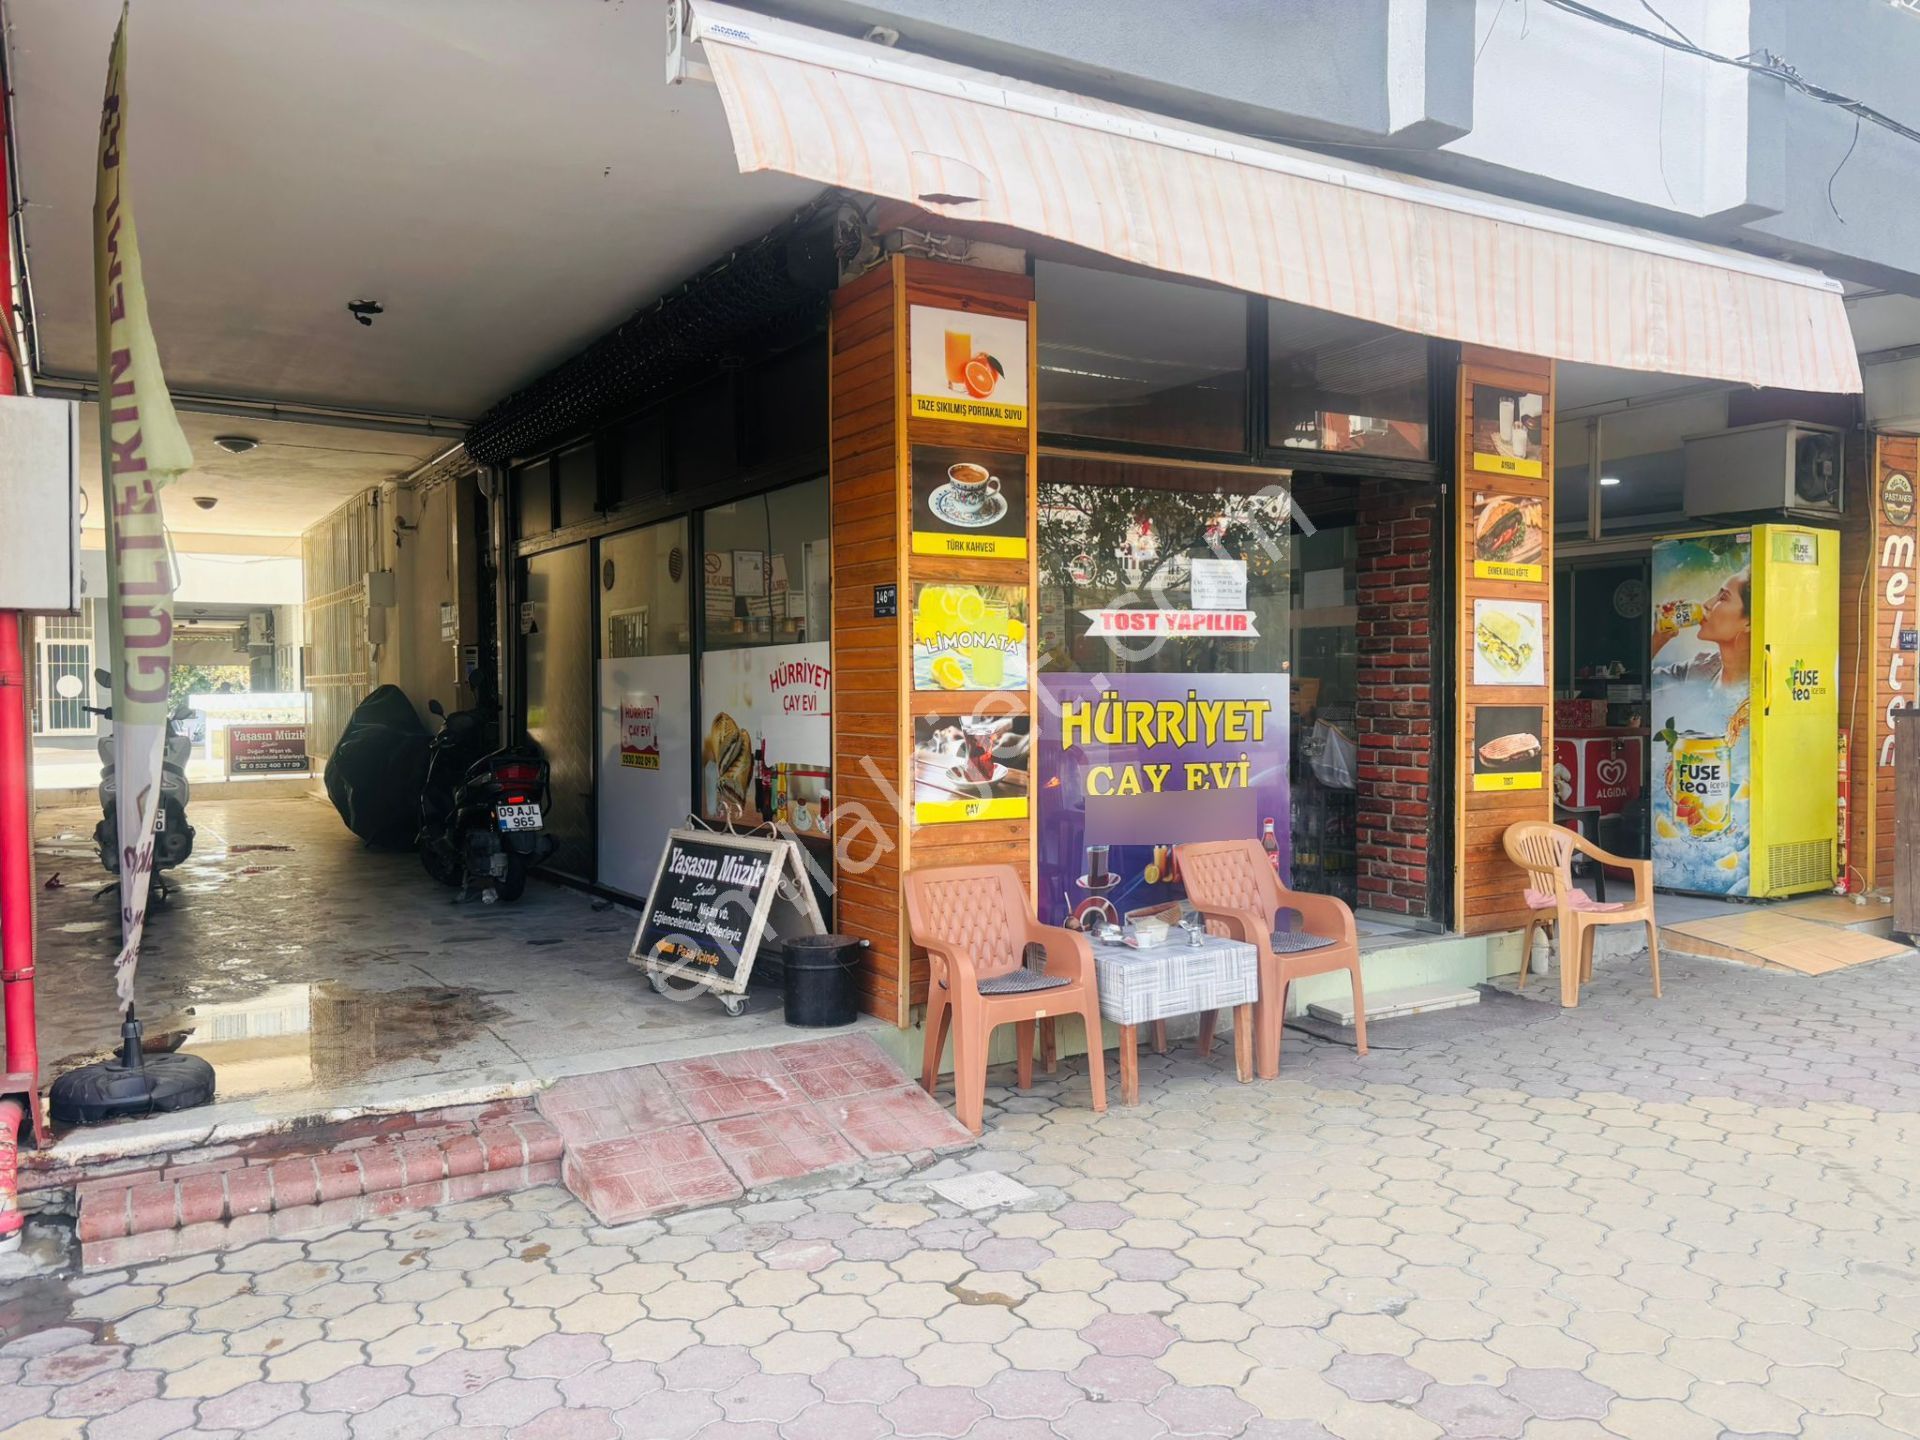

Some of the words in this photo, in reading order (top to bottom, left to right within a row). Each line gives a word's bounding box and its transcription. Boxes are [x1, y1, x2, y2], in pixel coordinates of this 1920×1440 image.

[917, 399, 935, 412] TAZE
[936, 401, 967, 417] SIKILMIŞ
[968, 406, 1003, 419] PORTAKAL
[1004, 408, 1022, 421] SUYU
[946, 539, 965, 552] TÜRK
[965, 540, 996, 553] KAHVESİ
[1100, 612, 1159, 631] TOST
[1165, 612, 1248, 632] YAPILIR
[925, 630, 1019, 656] LİMONATA
[769, 657, 831, 693] HÜRRİYET
[1793, 669, 1819, 687] FUSE
[783, 694, 801, 716] ÇAY
[802, 690, 817, 711] EVİ
[1791, 687, 1811, 701] tea
[1060, 688, 1272, 751] HÜRRİYET
[233, 730, 273, 744] Yaşasın
[275, 729, 306, 741] Müzik
[1183, 751, 1251, 791] EVİ
[1679, 764, 1721, 781] FUSE
[1596, 787, 1628, 799] ALGIDA
[1679, 779, 1709, 794] tea
[499, 806, 514, 818] 09
[516, 805, 539, 816] AJL
[513, 816, 536, 827] 965
[668, 846, 718, 883] Yaşasın
[717, 853, 766, 888] Müzik
[671, 896, 693, 914] Düğün
[698, 901, 718, 921] Nişan
[718, 908, 729, 921] vb.
[652, 909, 706, 935] Eğlencelerinizde
